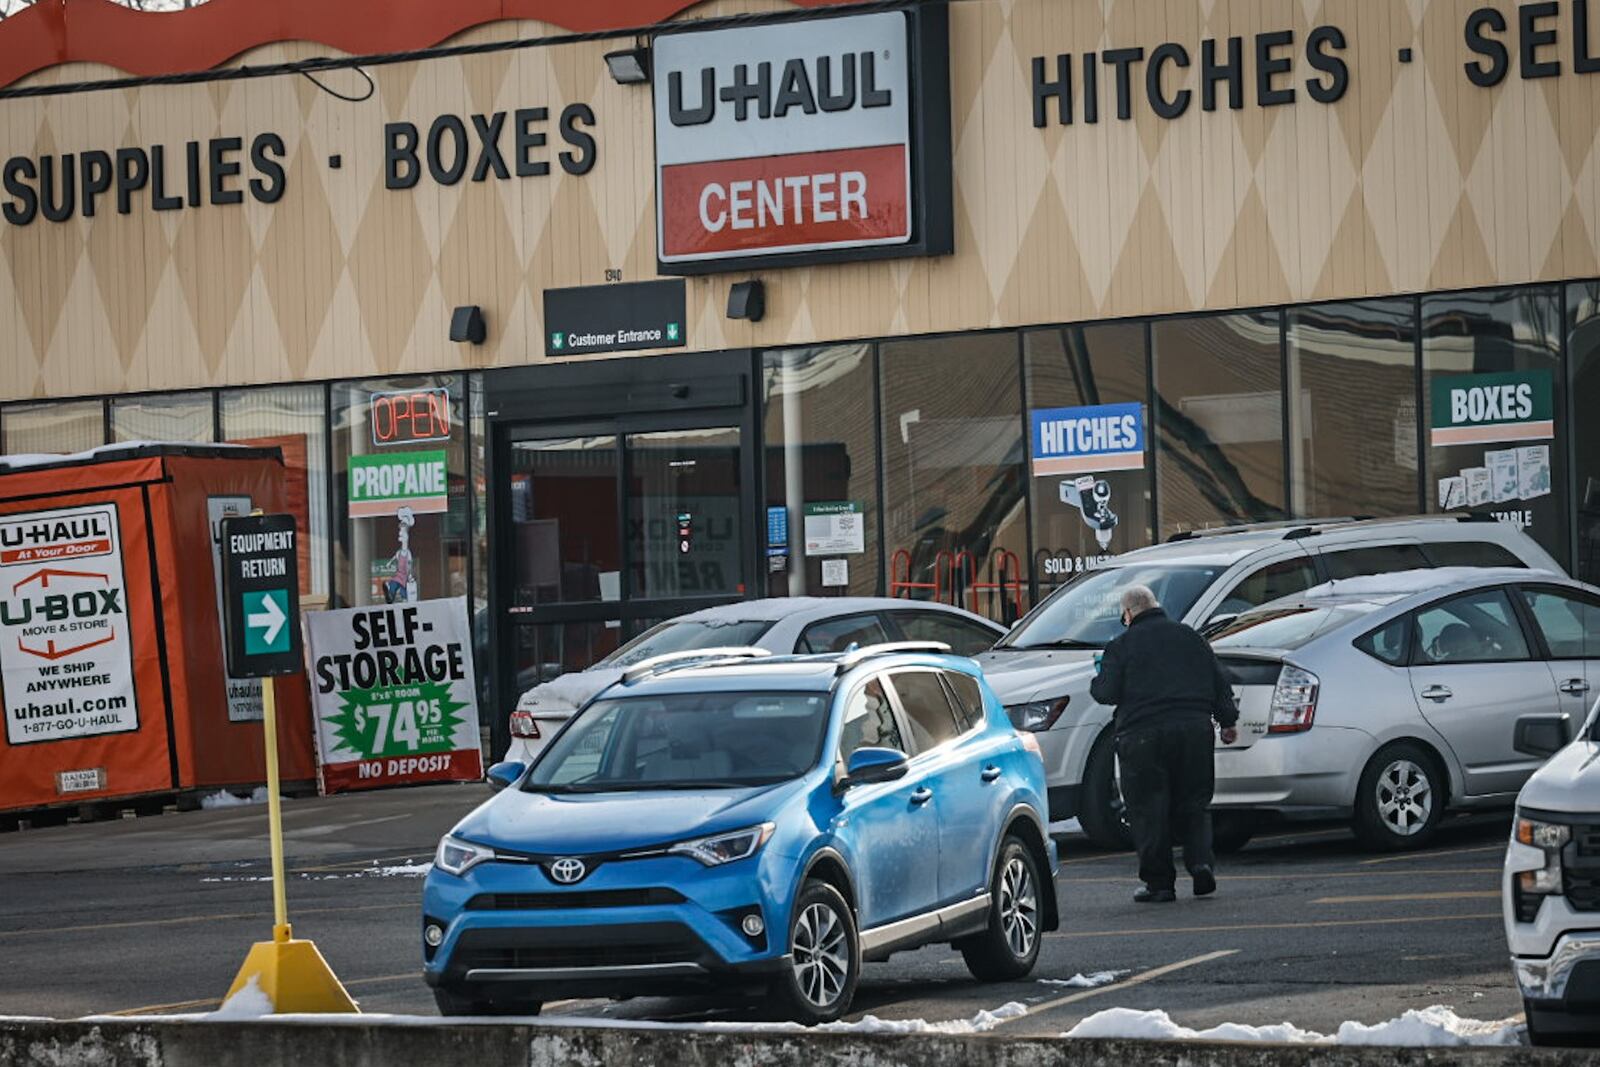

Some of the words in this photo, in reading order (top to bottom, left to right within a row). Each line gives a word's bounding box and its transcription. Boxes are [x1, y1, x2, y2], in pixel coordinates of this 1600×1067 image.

[1464, 0, 1600, 87] SEL
[668, 51, 892, 127] U-HAUL
[1032, 25, 1349, 128] HITCHES
[2, 132, 286, 226] SUPPLIES
[385, 103, 597, 190] BOXES
[699, 171, 868, 233] CENTER
[605, 269, 622, 281] 1340
[568, 333, 616, 347] Customer
[617, 329, 662, 343] Entrance
[374, 393, 449, 440] OPEN
[1451, 383, 1533, 423] BOXES
[1040, 414, 1137, 454] HITCHES
[352, 461, 445, 498] PROPANE
[1, 518, 107, 547] U-HAUL
[230, 530, 293, 554] EQUIPMENT
[17, 550, 32, 560] At
[35, 547, 63, 557] Your
[65, 543, 99, 554] Door
[241, 557, 286, 579] RETURN
[1044, 557, 1073, 574] SOLD
[1075, 556, 1084, 572] &
[1, 588, 123, 626] U-BOX
[22, 625, 56, 637] MOVE
[59, 624, 68, 633] &
[69, 619, 108, 632] STORE
[352, 607, 433, 650] SELF-
[26, 673, 111, 693] ANYWHERE
[38, 665, 60, 677] WE
[63, 661, 95, 674] SHIP
[316, 643, 465, 694] STORAGE
[14, 695, 127, 720] uhaul.com
[358, 761, 382, 779] NO
[387, 755, 451, 776] DEPOSIT
